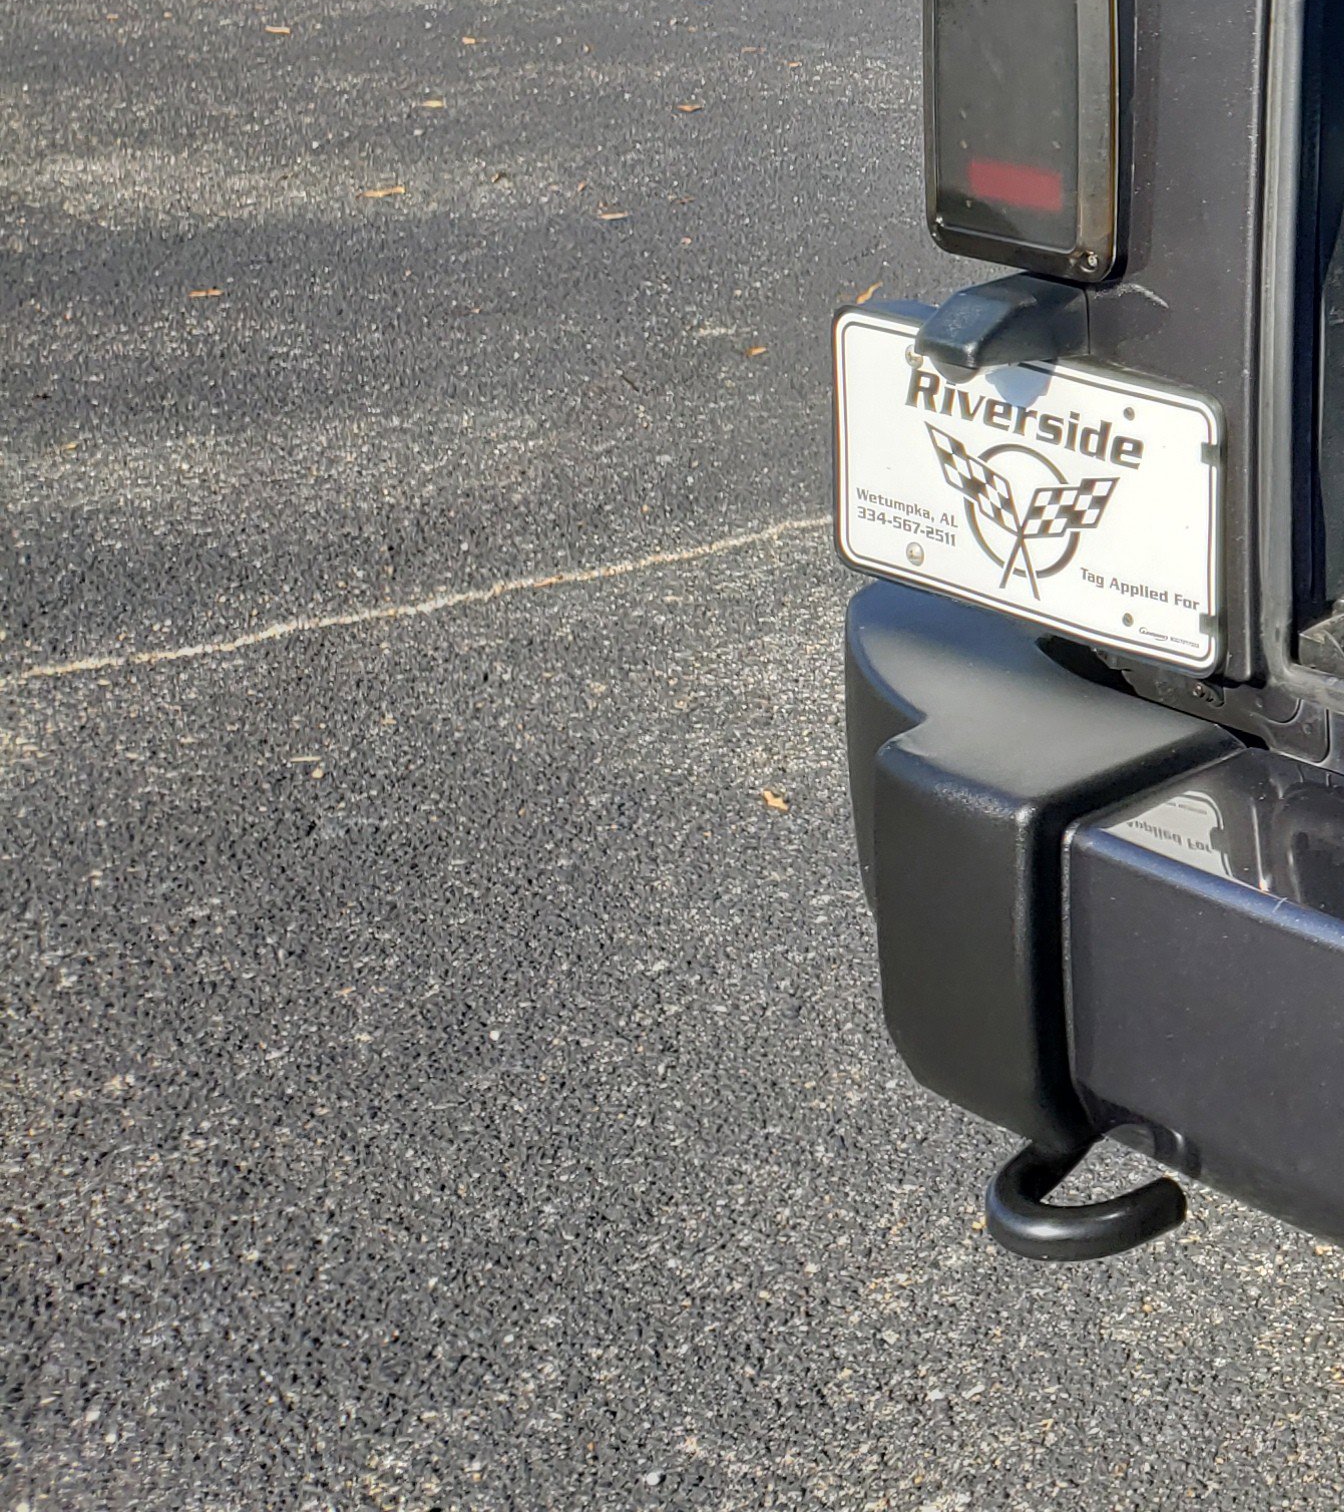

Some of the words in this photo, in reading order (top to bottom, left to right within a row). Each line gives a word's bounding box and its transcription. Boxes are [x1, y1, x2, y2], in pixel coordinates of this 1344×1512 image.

[905, 368, 1145, 470] Riverside
[856, 487, 935, 523] Wetumpka,
[940, 512, 959, 529] AL
[857, 506, 957, 547] 334-567-2511
[1080, 567, 1105, 589] Tag
[1109, 577, 1169, 603] Applied
[1174, 593, 1201, 611] For
